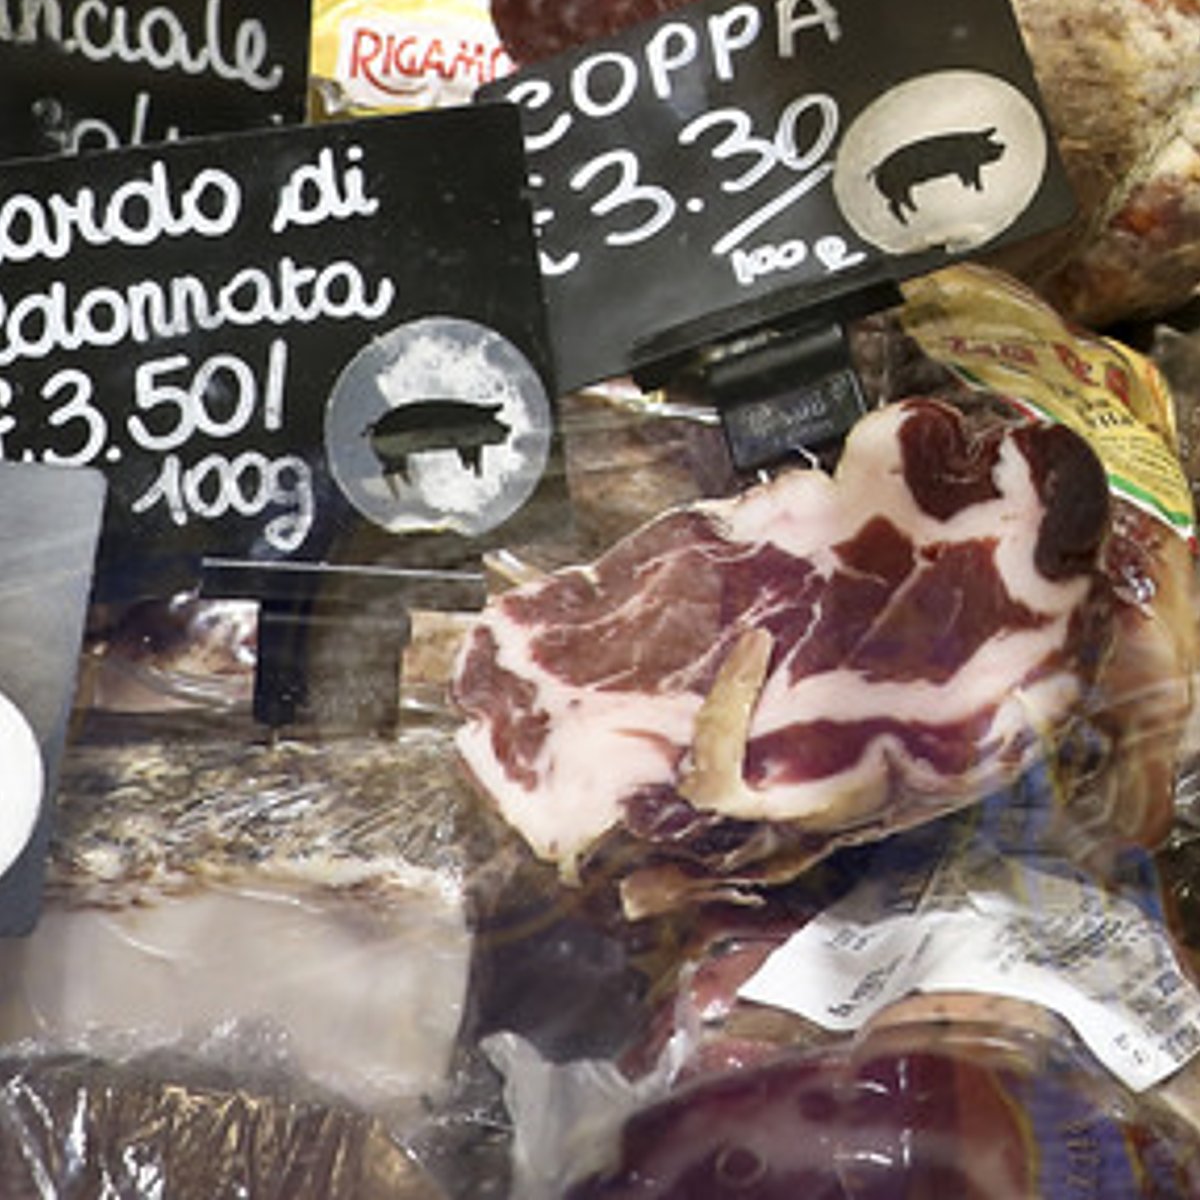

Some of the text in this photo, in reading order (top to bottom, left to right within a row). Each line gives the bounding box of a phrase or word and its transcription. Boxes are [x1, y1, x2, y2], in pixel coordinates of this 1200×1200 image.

[0, 147, 379, 262] ardo di
[131, 453, 313, 551] 100g
